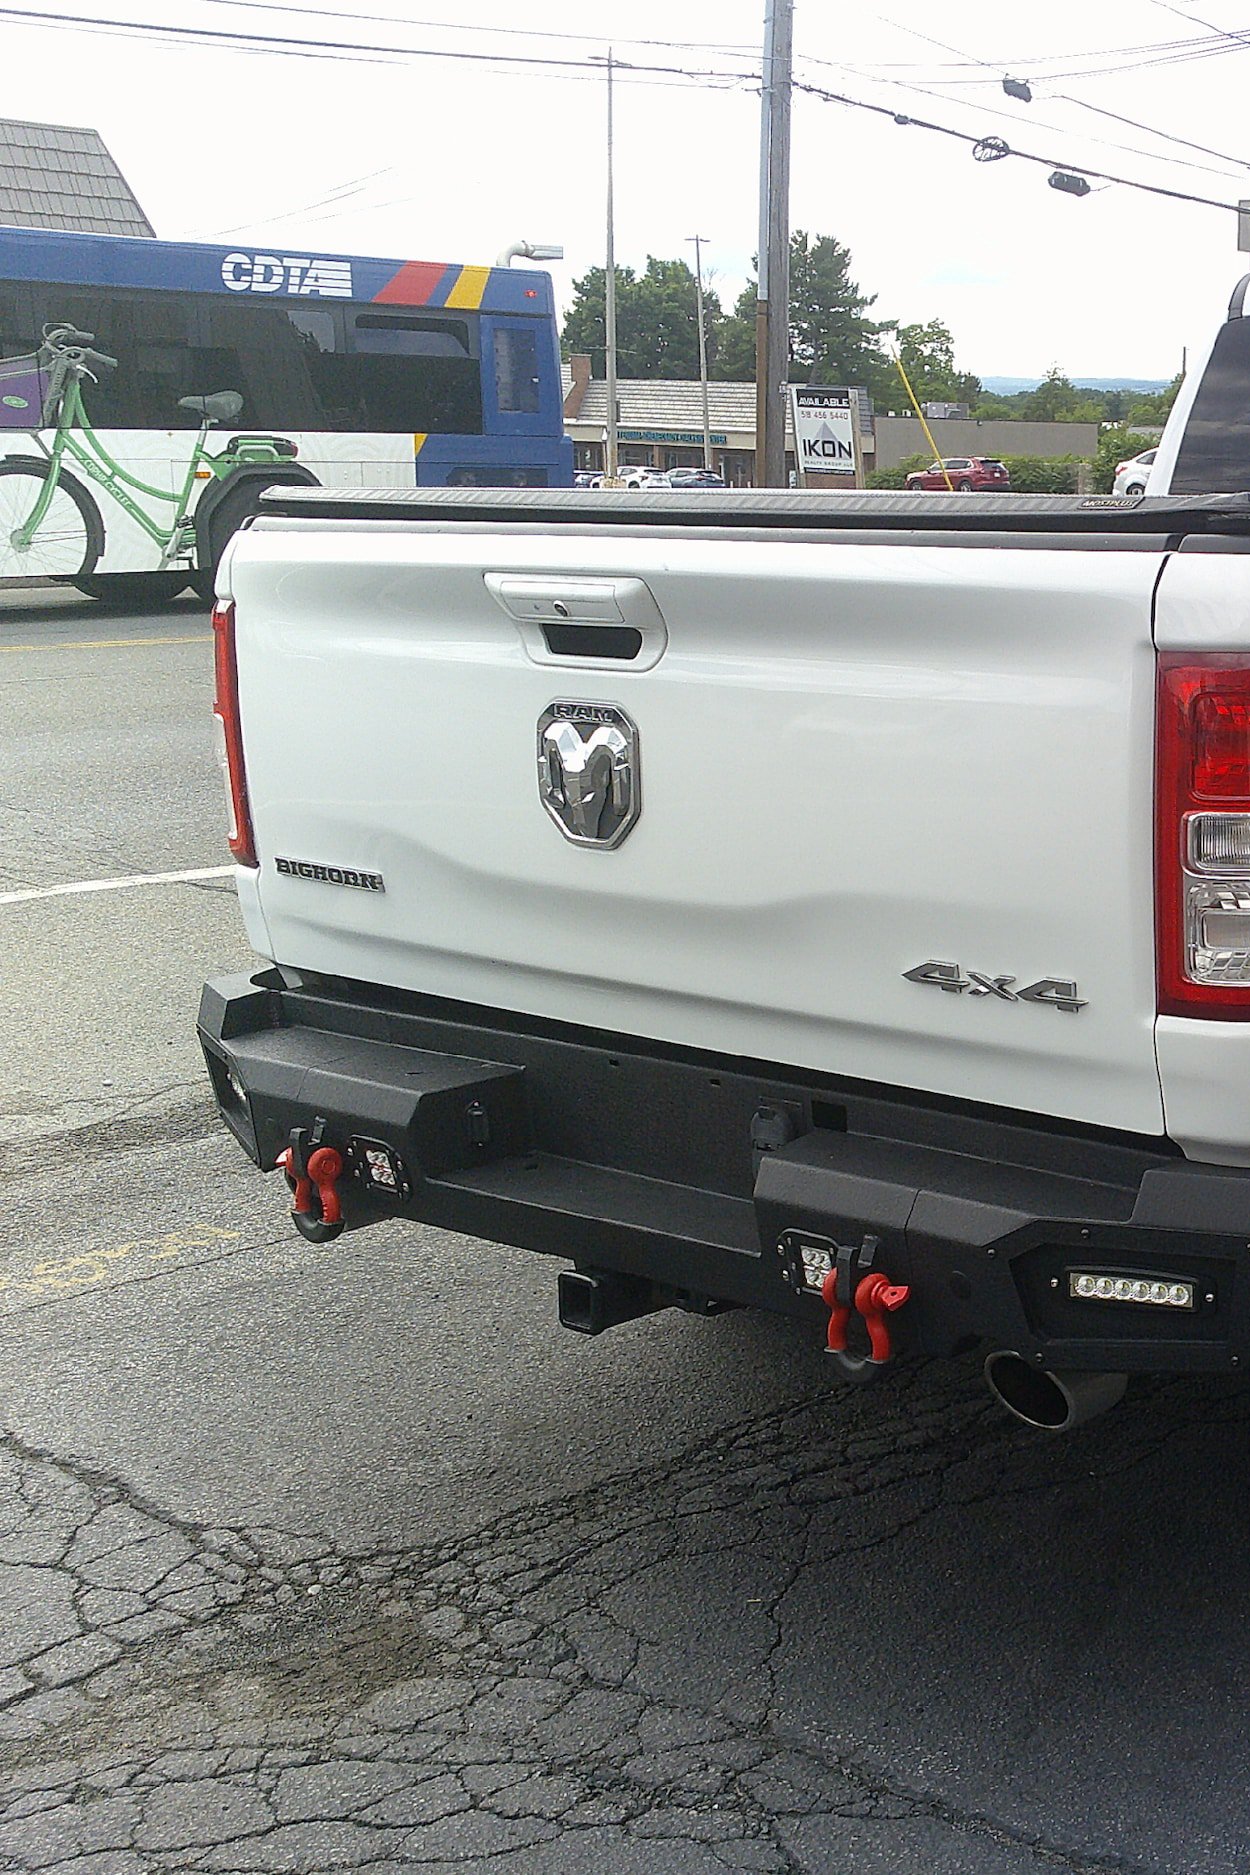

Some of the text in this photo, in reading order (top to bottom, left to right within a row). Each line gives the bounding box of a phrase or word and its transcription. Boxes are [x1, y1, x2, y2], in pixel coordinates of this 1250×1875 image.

[221, 252, 352, 297] CDTA
[798, 397, 850, 407] AVAILABLE
[829, 412, 849, 420] 5440
[803, 439, 853, 459] IKON
[553, 703, 614, 722] RAM
[273, 856, 386, 894] BIGHORN
